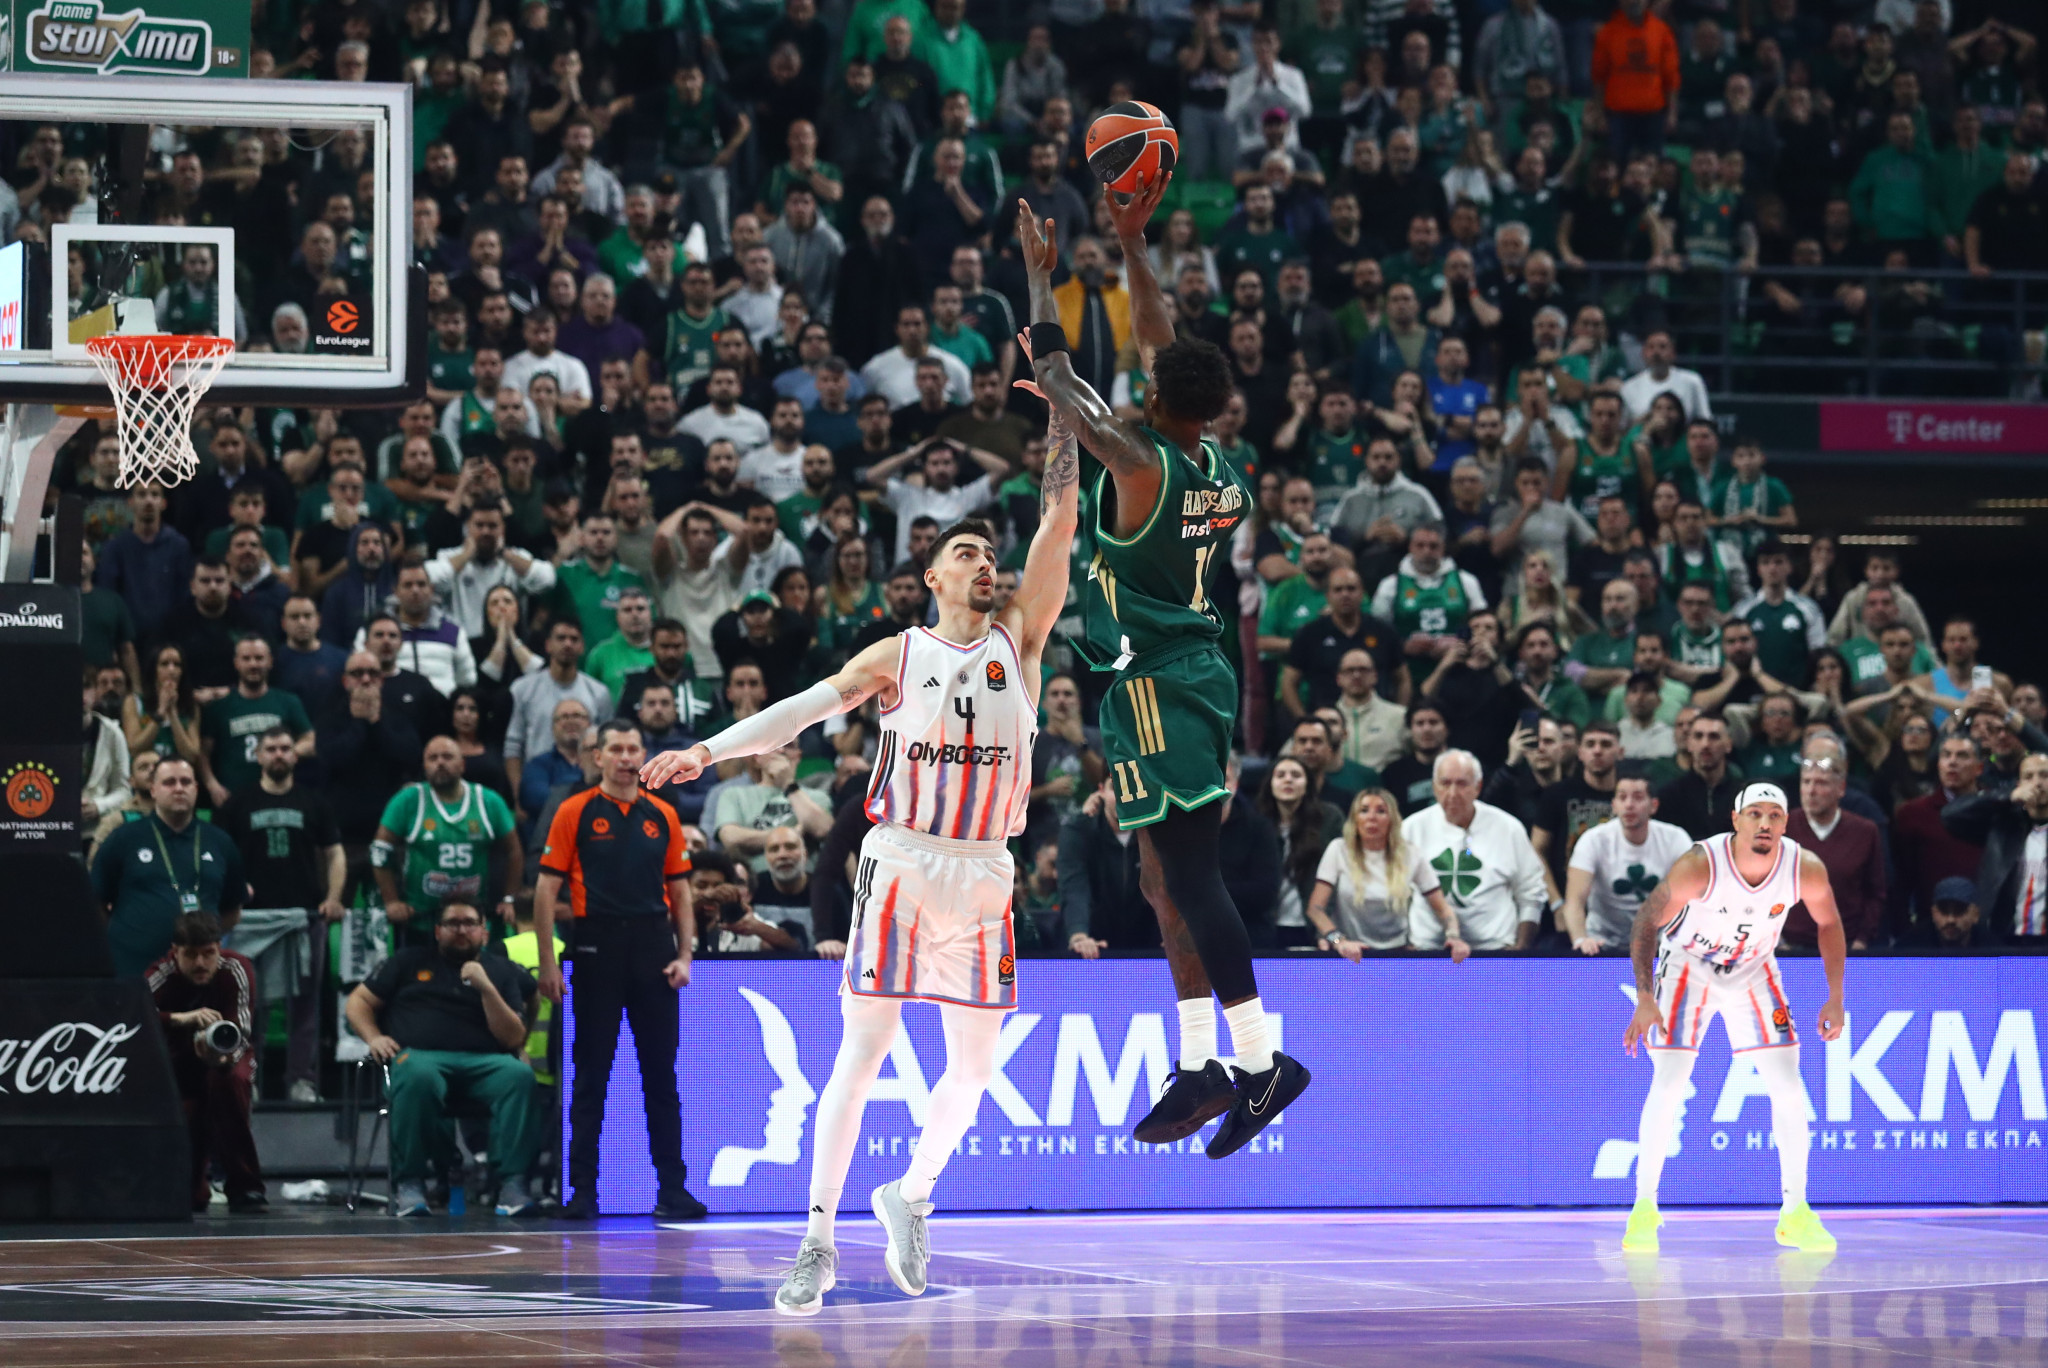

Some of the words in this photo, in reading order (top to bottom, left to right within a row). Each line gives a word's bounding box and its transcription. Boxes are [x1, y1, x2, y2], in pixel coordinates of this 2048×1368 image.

[52, 4, 93, 20] pame
[216, 50, 237, 65] 18+
[315, 334, 371, 349] EuroLeague
[1916, 413, 2005, 442] Center
[954, 696, 976, 735] 4
[907, 741, 1009, 768] OlyBOOST
[1113, 760, 1149, 804] 11
[14, 831, 46, 840] AKTOR
[438, 843, 473, 868] 25
[1733, 923, 1753, 942] 5
